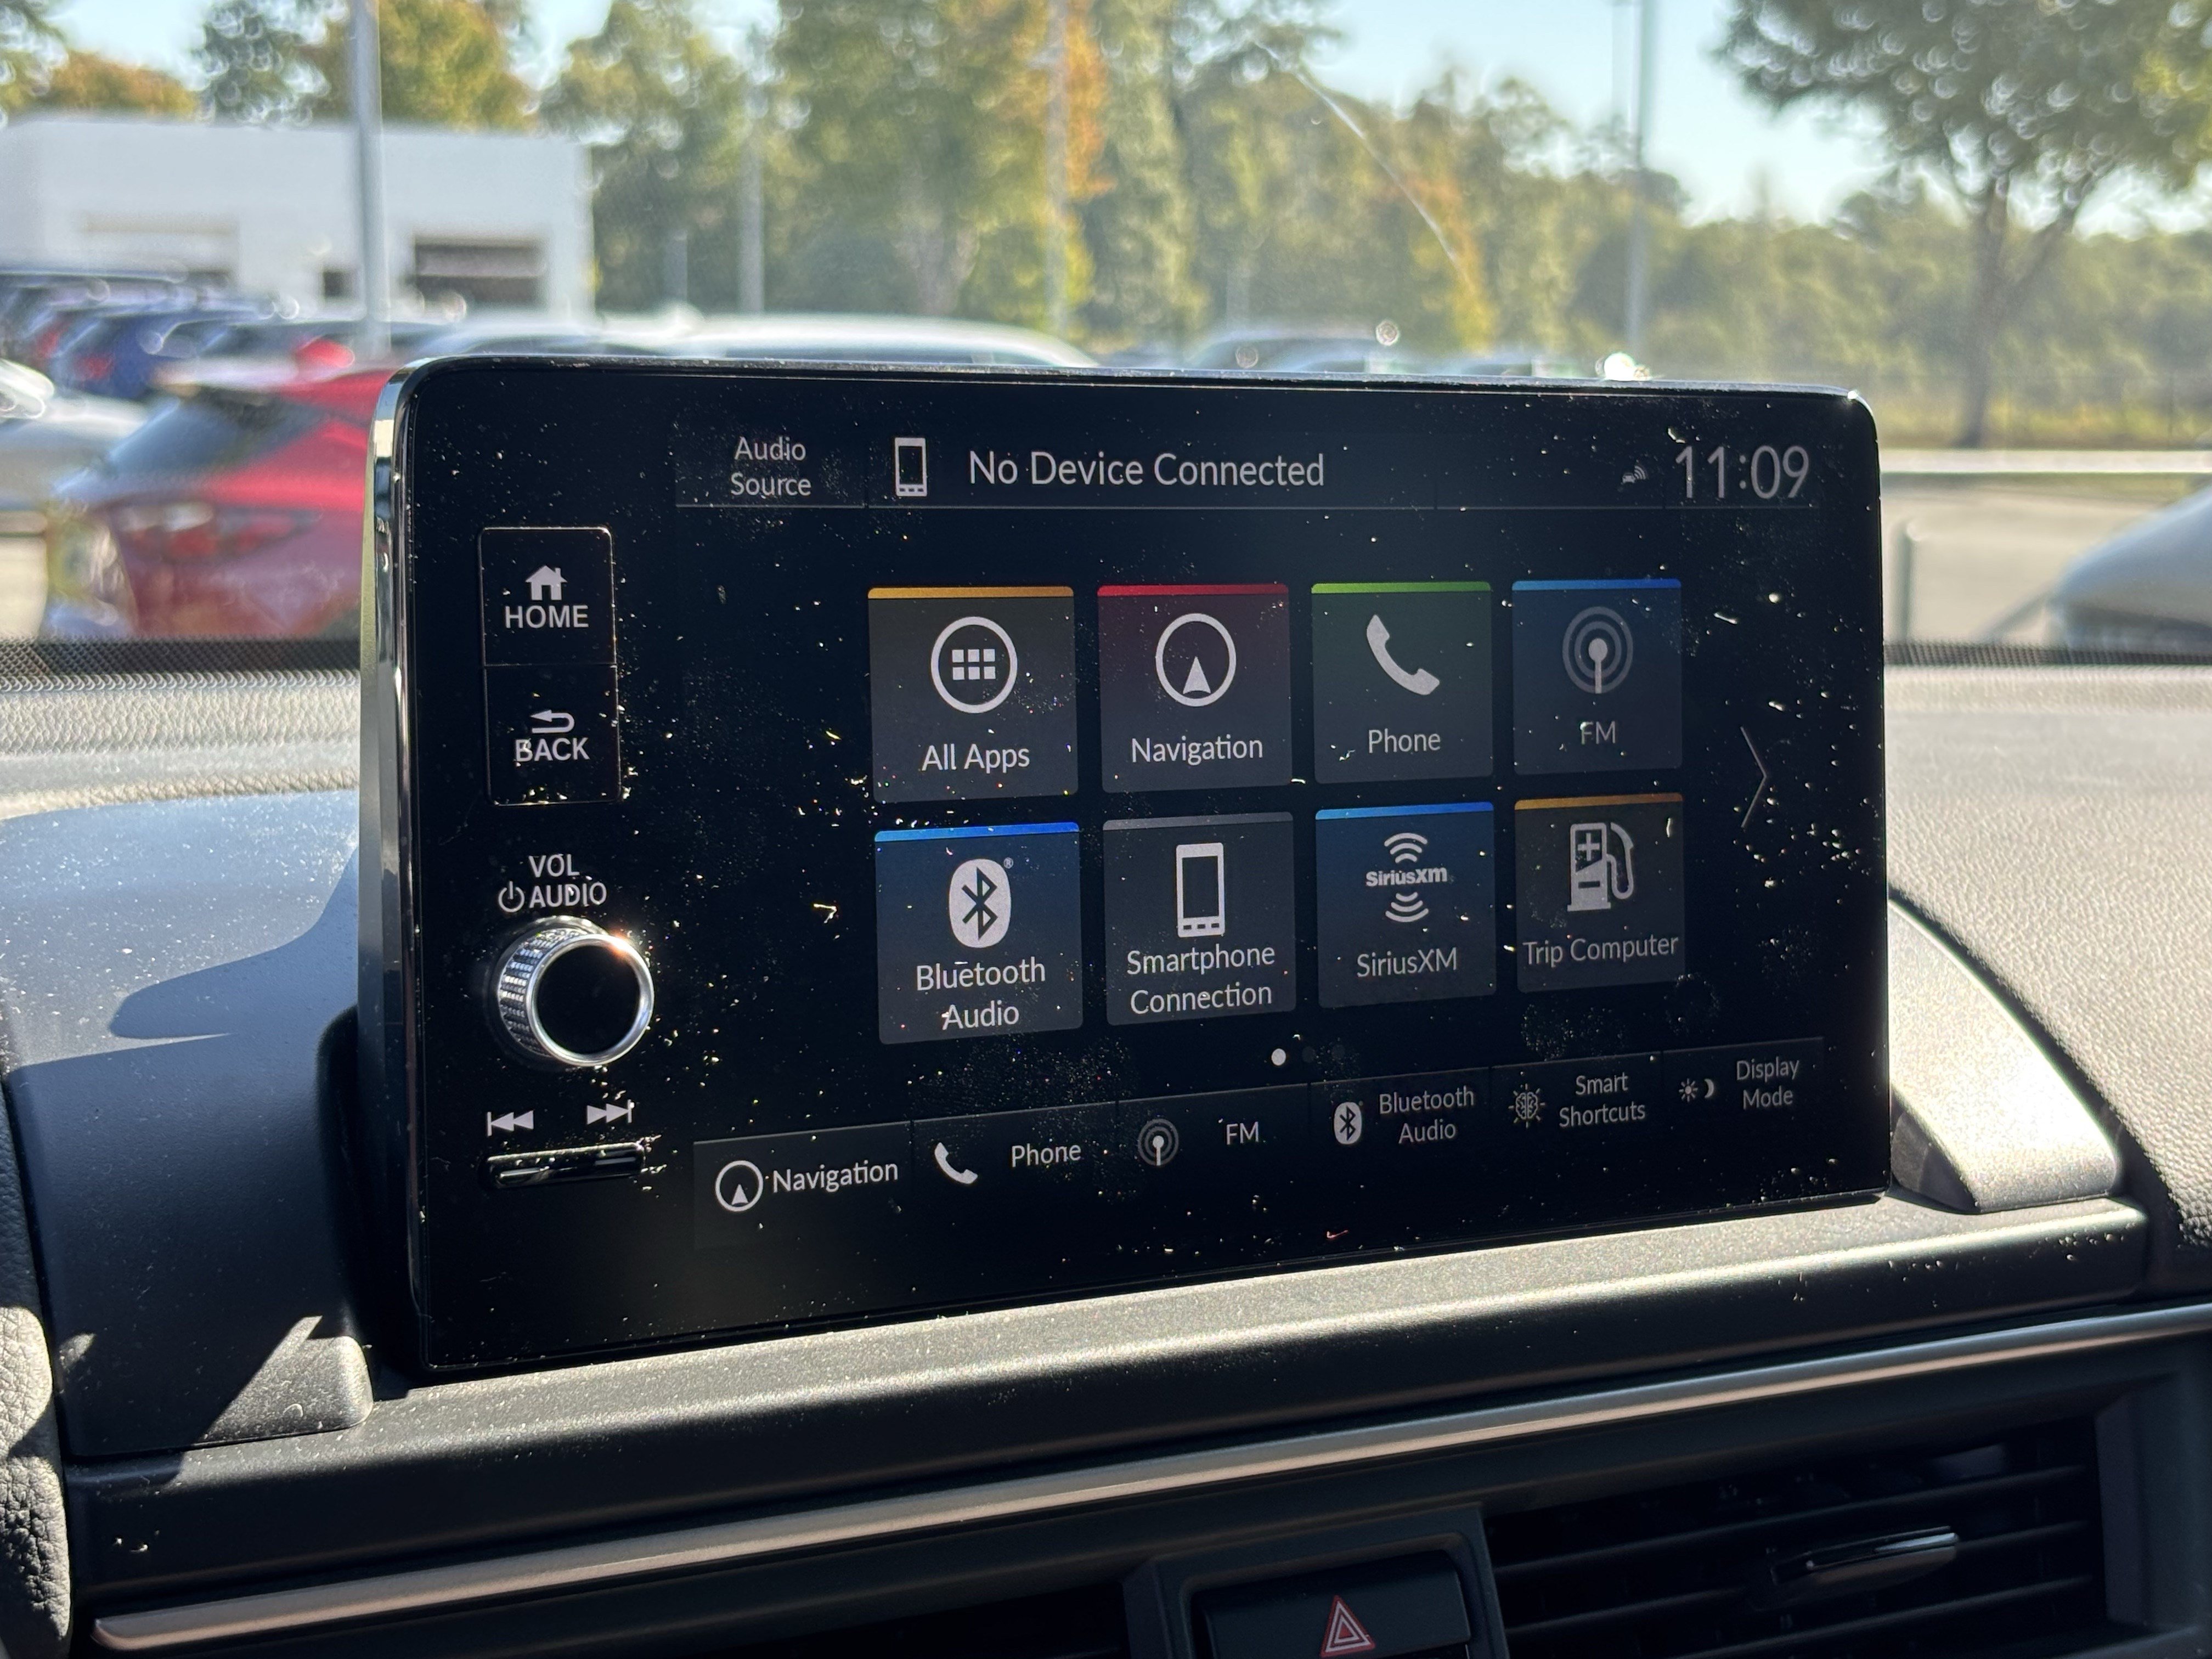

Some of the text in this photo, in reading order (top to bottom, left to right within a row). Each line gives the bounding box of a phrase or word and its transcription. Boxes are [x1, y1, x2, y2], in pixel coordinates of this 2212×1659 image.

[734, 437, 806, 462] Audio
[970, 452, 1324, 486] No Device Connected
[1675, 445, 1809, 499] 11:09
[731, 472, 811, 497] Source
[505, 605, 589, 628] HOME
[1368, 729, 1441, 754] Phone
[1581, 721, 1616, 745] FM
[516, 737, 589, 762] BACK
[922, 744, 1029, 774] All Apps
[1132, 734, 1263, 766] Navigation
[529, 854, 579, 877] VOL
[529, 881, 607, 908] AUDIO
[1127, 943, 1275, 980] Smartphone
[1357, 946, 1458, 978] SiriusXM
[1523, 934, 1679, 968] Trip Computer
[917, 957, 1046, 991] Bluetooth
[1130, 983, 1272, 1014] Connection
[943, 1000, 1019, 1030] Audio
[1736, 1056, 1799, 1081] Display
[1575, 1072, 1629, 1096] Smart
[1379, 1085, 1474, 1115] Bluetooth
[1742, 1086, 1793, 1109] Mode
[1559, 1101, 1646, 1127] Shortcuts
[1226, 1121, 1259, 1144] FM
[1398, 1120, 1457, 1144] Audio
[1011, 1142, 1081, 1167] Phone
[772, 1159, 898, 1194] Navigation
